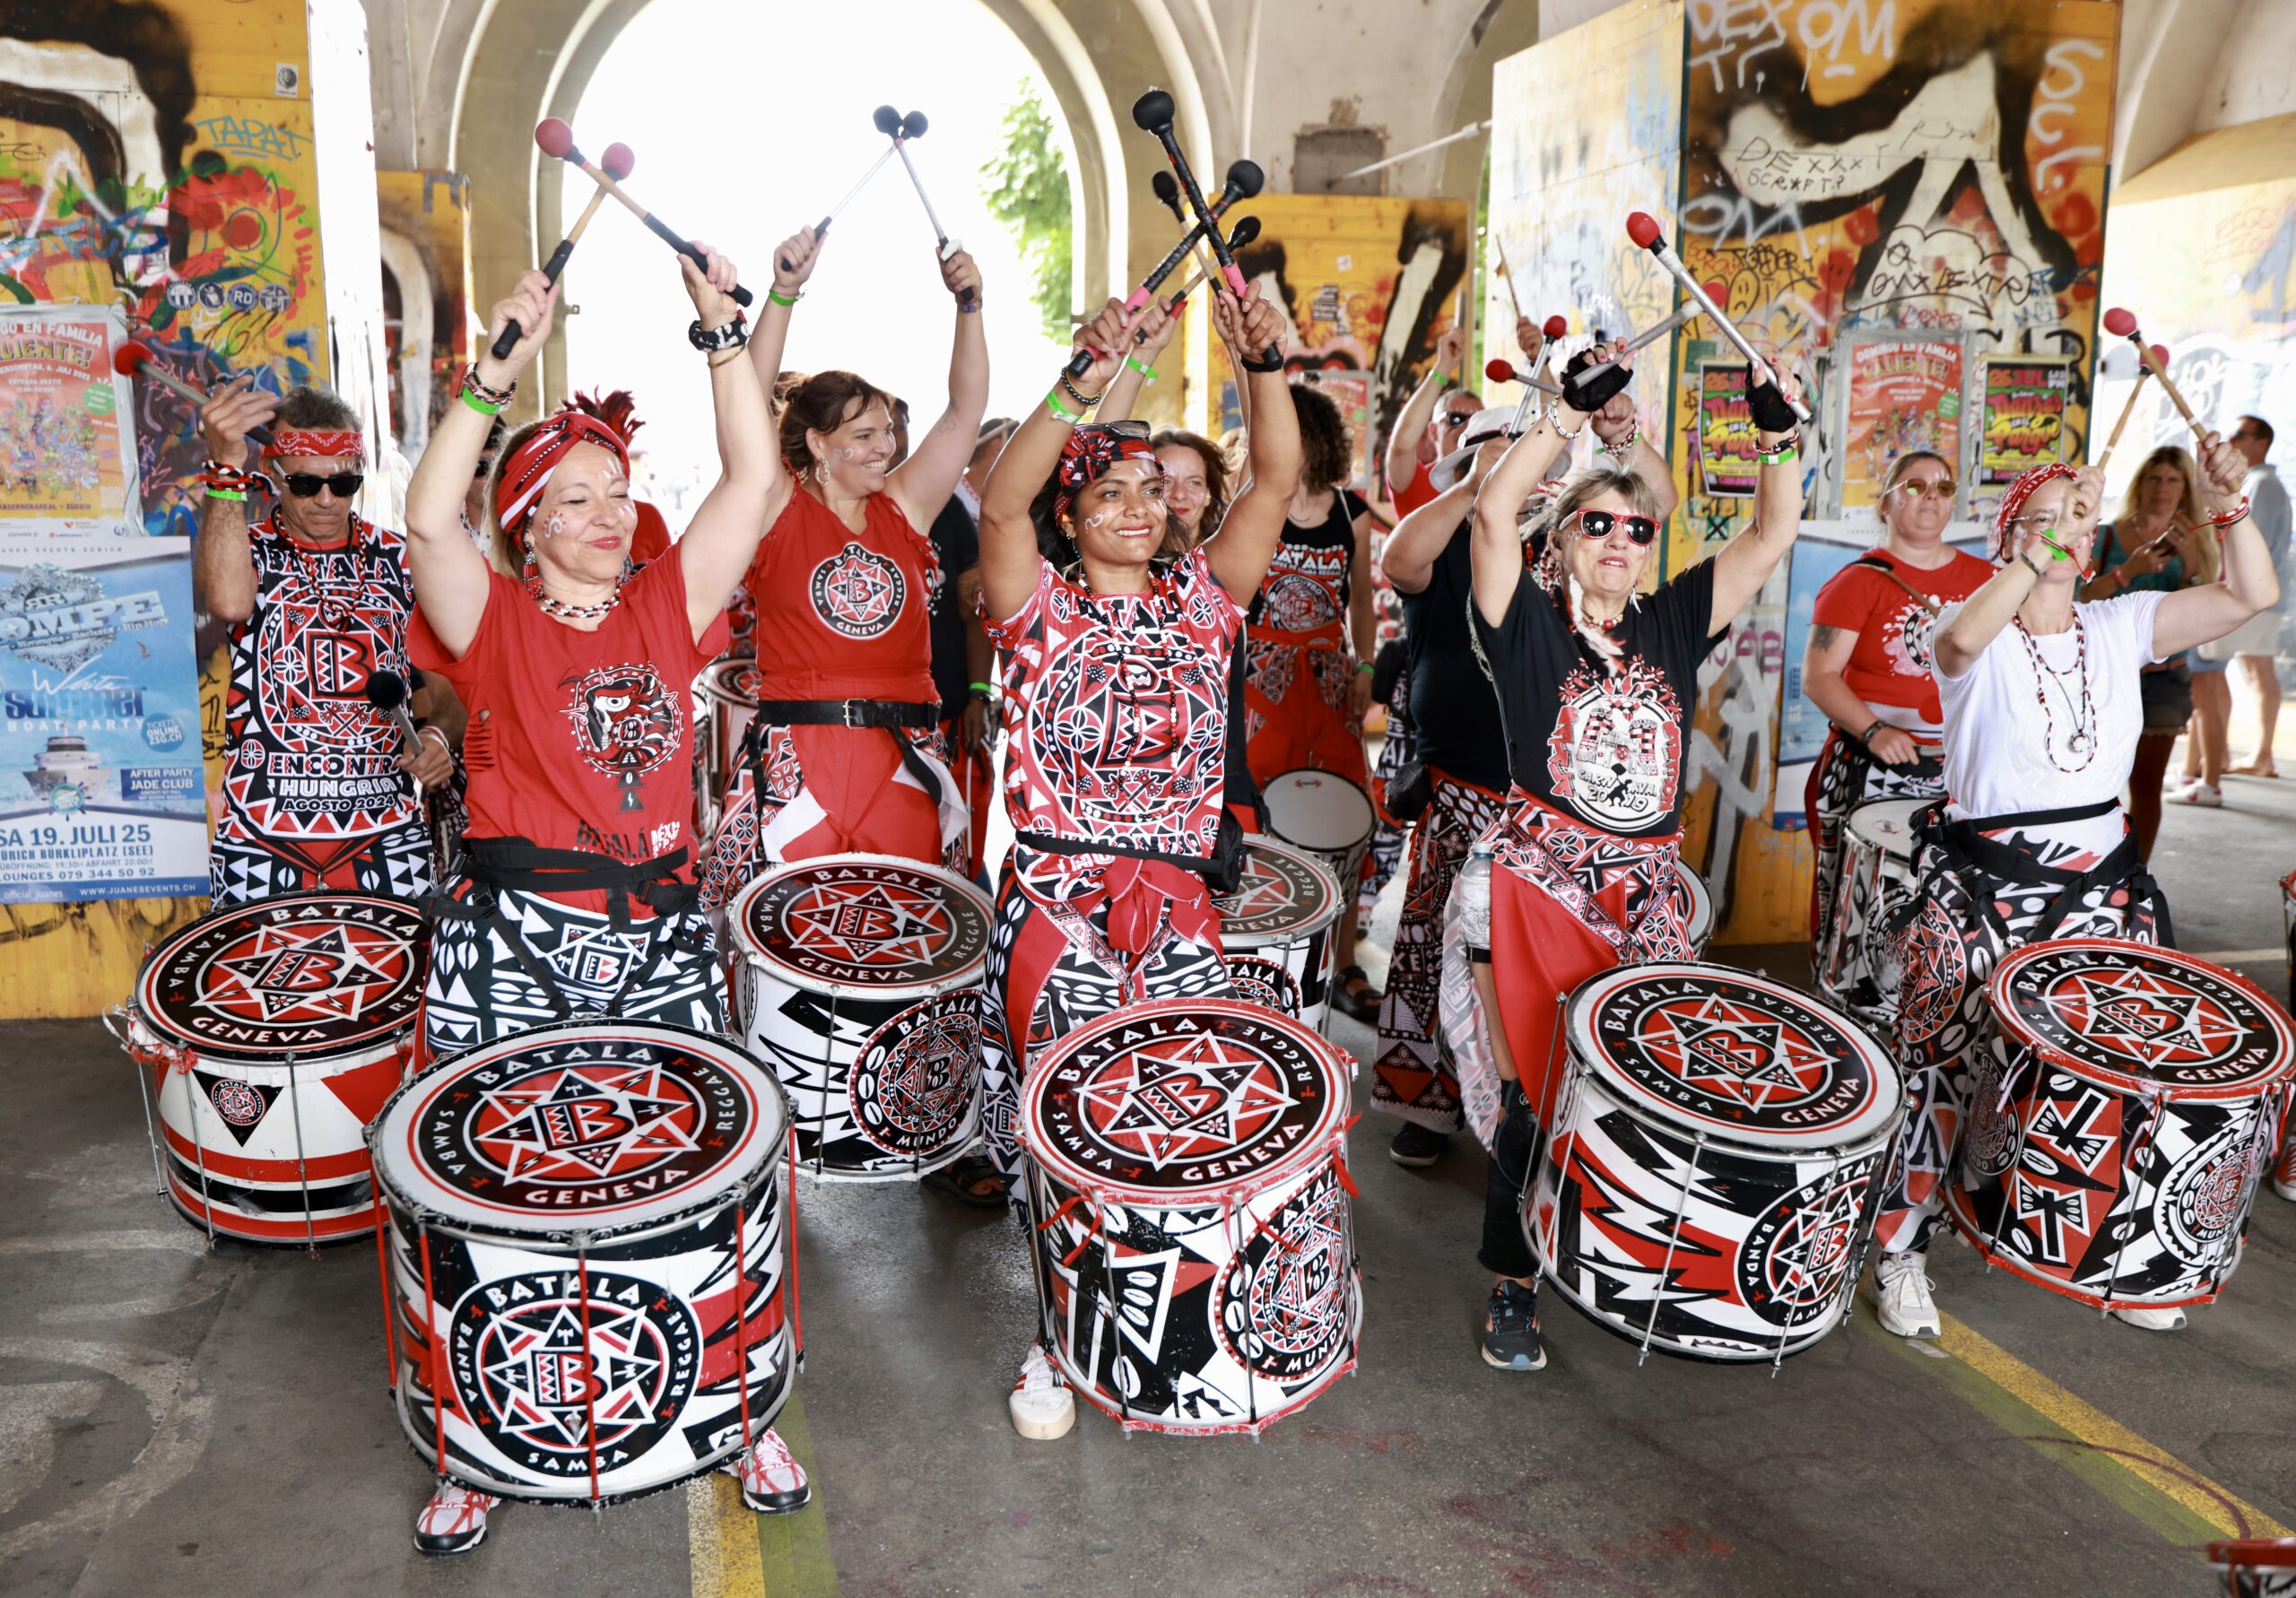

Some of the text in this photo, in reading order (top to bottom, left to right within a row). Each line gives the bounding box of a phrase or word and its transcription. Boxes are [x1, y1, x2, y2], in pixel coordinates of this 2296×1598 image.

[234, 290, 253, 306] RD
[22, 323, 42, 334] EN
[47, 324, 104, 348] FAMILIA
[57, 365, 72, 375] JULI
[73, 369, 91, 381] 2025
[2013, 369, 2048, 387] JUL
[83, 545, 123, 553] ZÜRICH
[815, 568, 827, 606] SAMBA
[890, 567, 903, 607] REGGAE
[836, 621, 885, 636] GENEVA
[7, 718, 144, 733] BOAT PARTY
[146, 725, 179, 737] ONLINE
[130, 768, 194, 778] AFTER PARTY
[131, 778, 194, 790] JADE CLUB
[279, 777, 397, 797] HUNGRIA
[284, 795, 396, 812] AGOSTO 2024
[1587, 785, 1649, 812] 20 19
[30, 827, 65, 847] 19.
[70, 825, 116, 846] JULI
[122, 824, 151, 843] 25
[40, 845, 118, 860] BÜRKLIPLATZ
[123, 845, 154, 856] (SEE)
[59, 870, 83, 880] 079
[89, 869, 112, 879] 344
[118, 868, 134, 878] 50
[140, 867, 155, 877] 92
[86, 858, 121, 868] ABFAHRT
[1274, 857, 1317, 898] REGGAE
[80, 883, 196, 896] WWW.JUANESEVENTS.CH
[814, 867, 943, 897] BATALA
[270, 904, 421, 938] BATALA
[760, 888, 789, 934] SAMBA
[1225, 915, 1296, 933] NEVA
[952, 910, 980, 960] REGGAE
[169, 932, 226, 988] SAMBA
[797, 956, 916, 981] GENEVA
[1225, 963, 1276, 985] TALA
[2016, 953, 2126, 994] BATALA
[1605, 981, 1704, 1031] BATALA
[2168, 967, 2255, 1017] REGGAE
[192, 1016, 327, 1044] GENEVA
[898, 997, 978, 1036] BATALA
[1745, 992, 1837, 1043] REGGAE
[1057, 1017, 1199, 1082] BATALA
[1242, 1024, 1313, 1082] REGGAE
[2031, 1012, 2109, 1064] SAMBA
[473, 1045, 655, 1086] BATALA
[2176, 1047, 2270, 1082] GENEVA
[691, 1066, 738, 1132] REGGAE
[1624, 1058, 1714, 1113] SAMBA
[1780, 1077, 1862, 1124] GENEVA
[432, 1109, 463, 1177] SAMBA
[896, 1116, 958, 1148] MUNDO
[1052, 1111, 1113, 1171] SAMBA
[1182, 1123, 1305, 1182] GENEVA
[524, 1168, 690, 1204] GENEVA
[1799, 1157, 1881, 1203] BATA
[2196, 1221, 2231, 1239] MUND
[1745, 1222, 1775, 1287] BANDA
[485, 1275, 642, 1308] BATALA
[665, 1310, 693, 1397] REGGAE
[1285, 1311, 1345, 1374] MUNDO
[456, 1322, 479, 1403] BANDA
[527, 1450, 630, 1472] SAMBA
